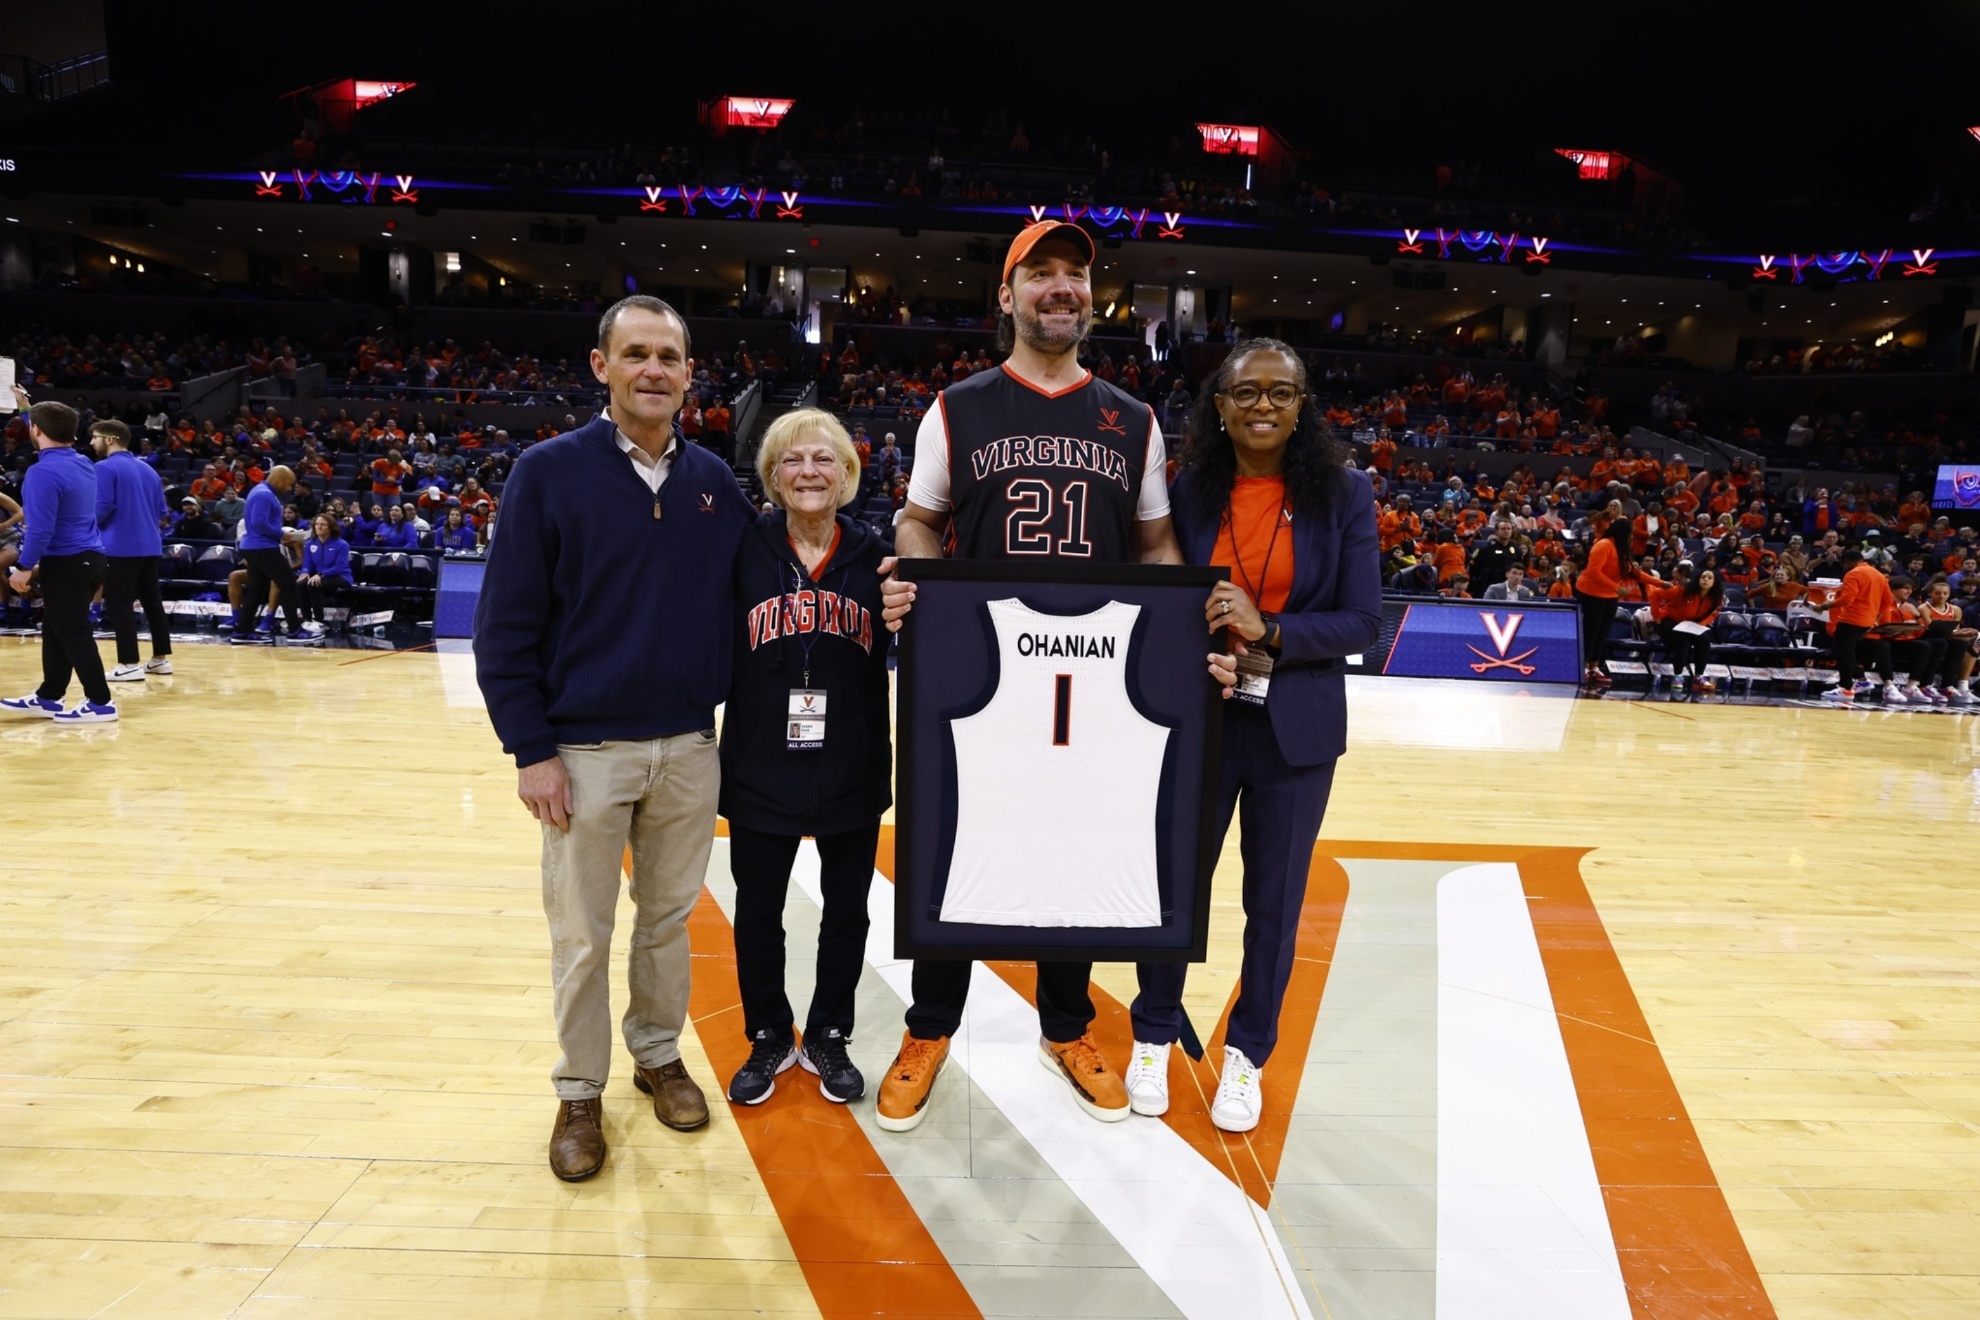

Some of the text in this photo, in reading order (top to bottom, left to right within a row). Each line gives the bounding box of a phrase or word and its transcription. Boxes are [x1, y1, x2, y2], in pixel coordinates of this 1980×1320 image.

[259, 171, 277, 188] V
[395, 175, 413, 194] V
[645, 186, 662, 203] V
[781, 191, 799, 210] V
[1164, 212, 1181, 230] V
[1404, 228, 1421, 246] V
[1532, 237, 1549, 255] V
[1760, 255, 1776, 271] V
[1912, 248, 1935, 267] V
[1100, 408, 1119, 426] V
[972, 435, 1129, 491] VIRGINIA
[701, 493, 713, 506] V
[1007, 478, 1092, 557] 21
[747, 590, 873, 656] VIRGINIA
[1479, 612, 1524, 658] V
[1017, 632, 1115, 659] OHANIAN
[803, 696, 814, 708] V
[1240, 695, 1265, 705] ACCESS
[1053, 674, 1072, 746] 1
